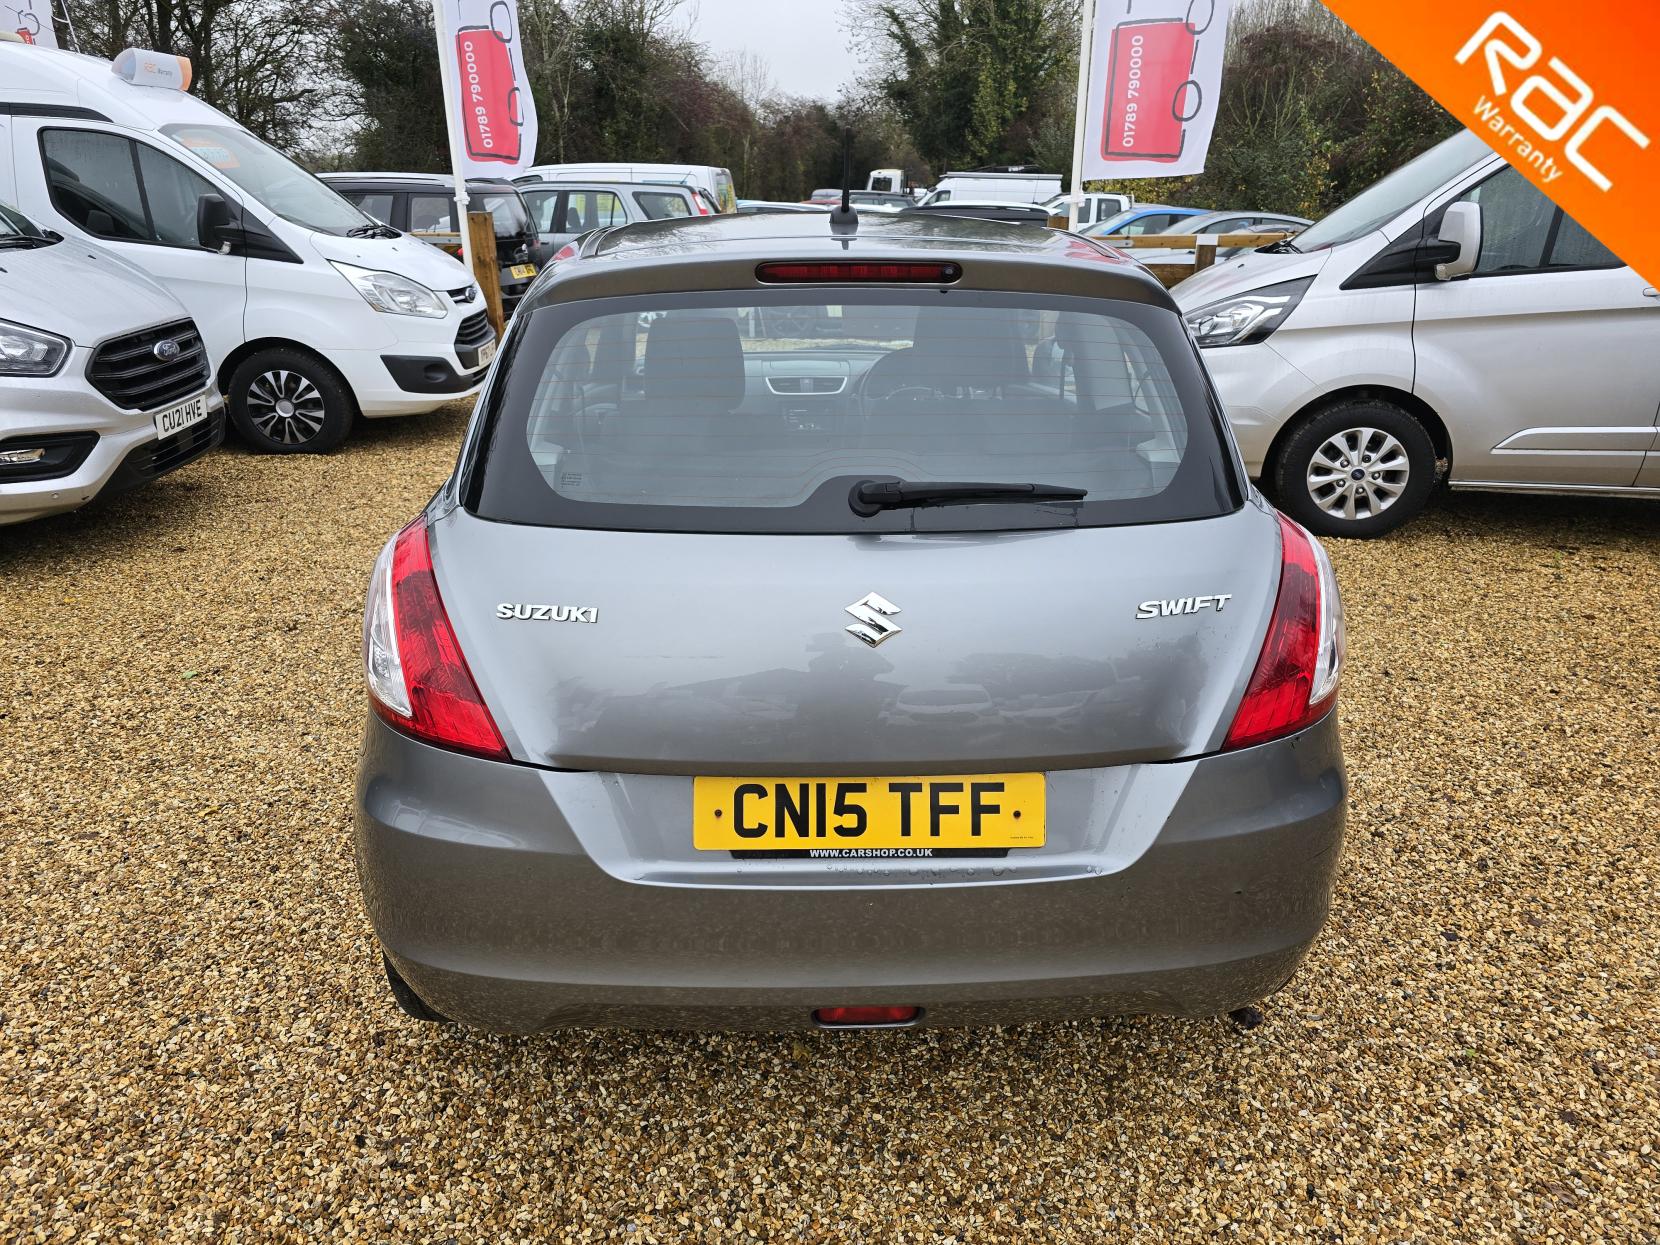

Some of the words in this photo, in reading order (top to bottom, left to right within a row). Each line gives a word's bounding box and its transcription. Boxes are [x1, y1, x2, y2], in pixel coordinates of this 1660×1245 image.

[464, 41, 484, 102] 790000
[1127, 35, 1144, 99] 790000
[475, 106, 493, 149] 01789
[1122, 104, 1138, 147] 01789
[162, 406, 185, 432] CU21
[185, 399, 202, 423] HVE
[496, 603, 598, 623] SUZUKI
[1136, 594, 1232, 619] SWIFT
[733, 783, 867, 838] CN15
[888, 782, 1005, 837] TFF
[810, 848, 933, 858] WWW.CARSHOP.CO.UK
